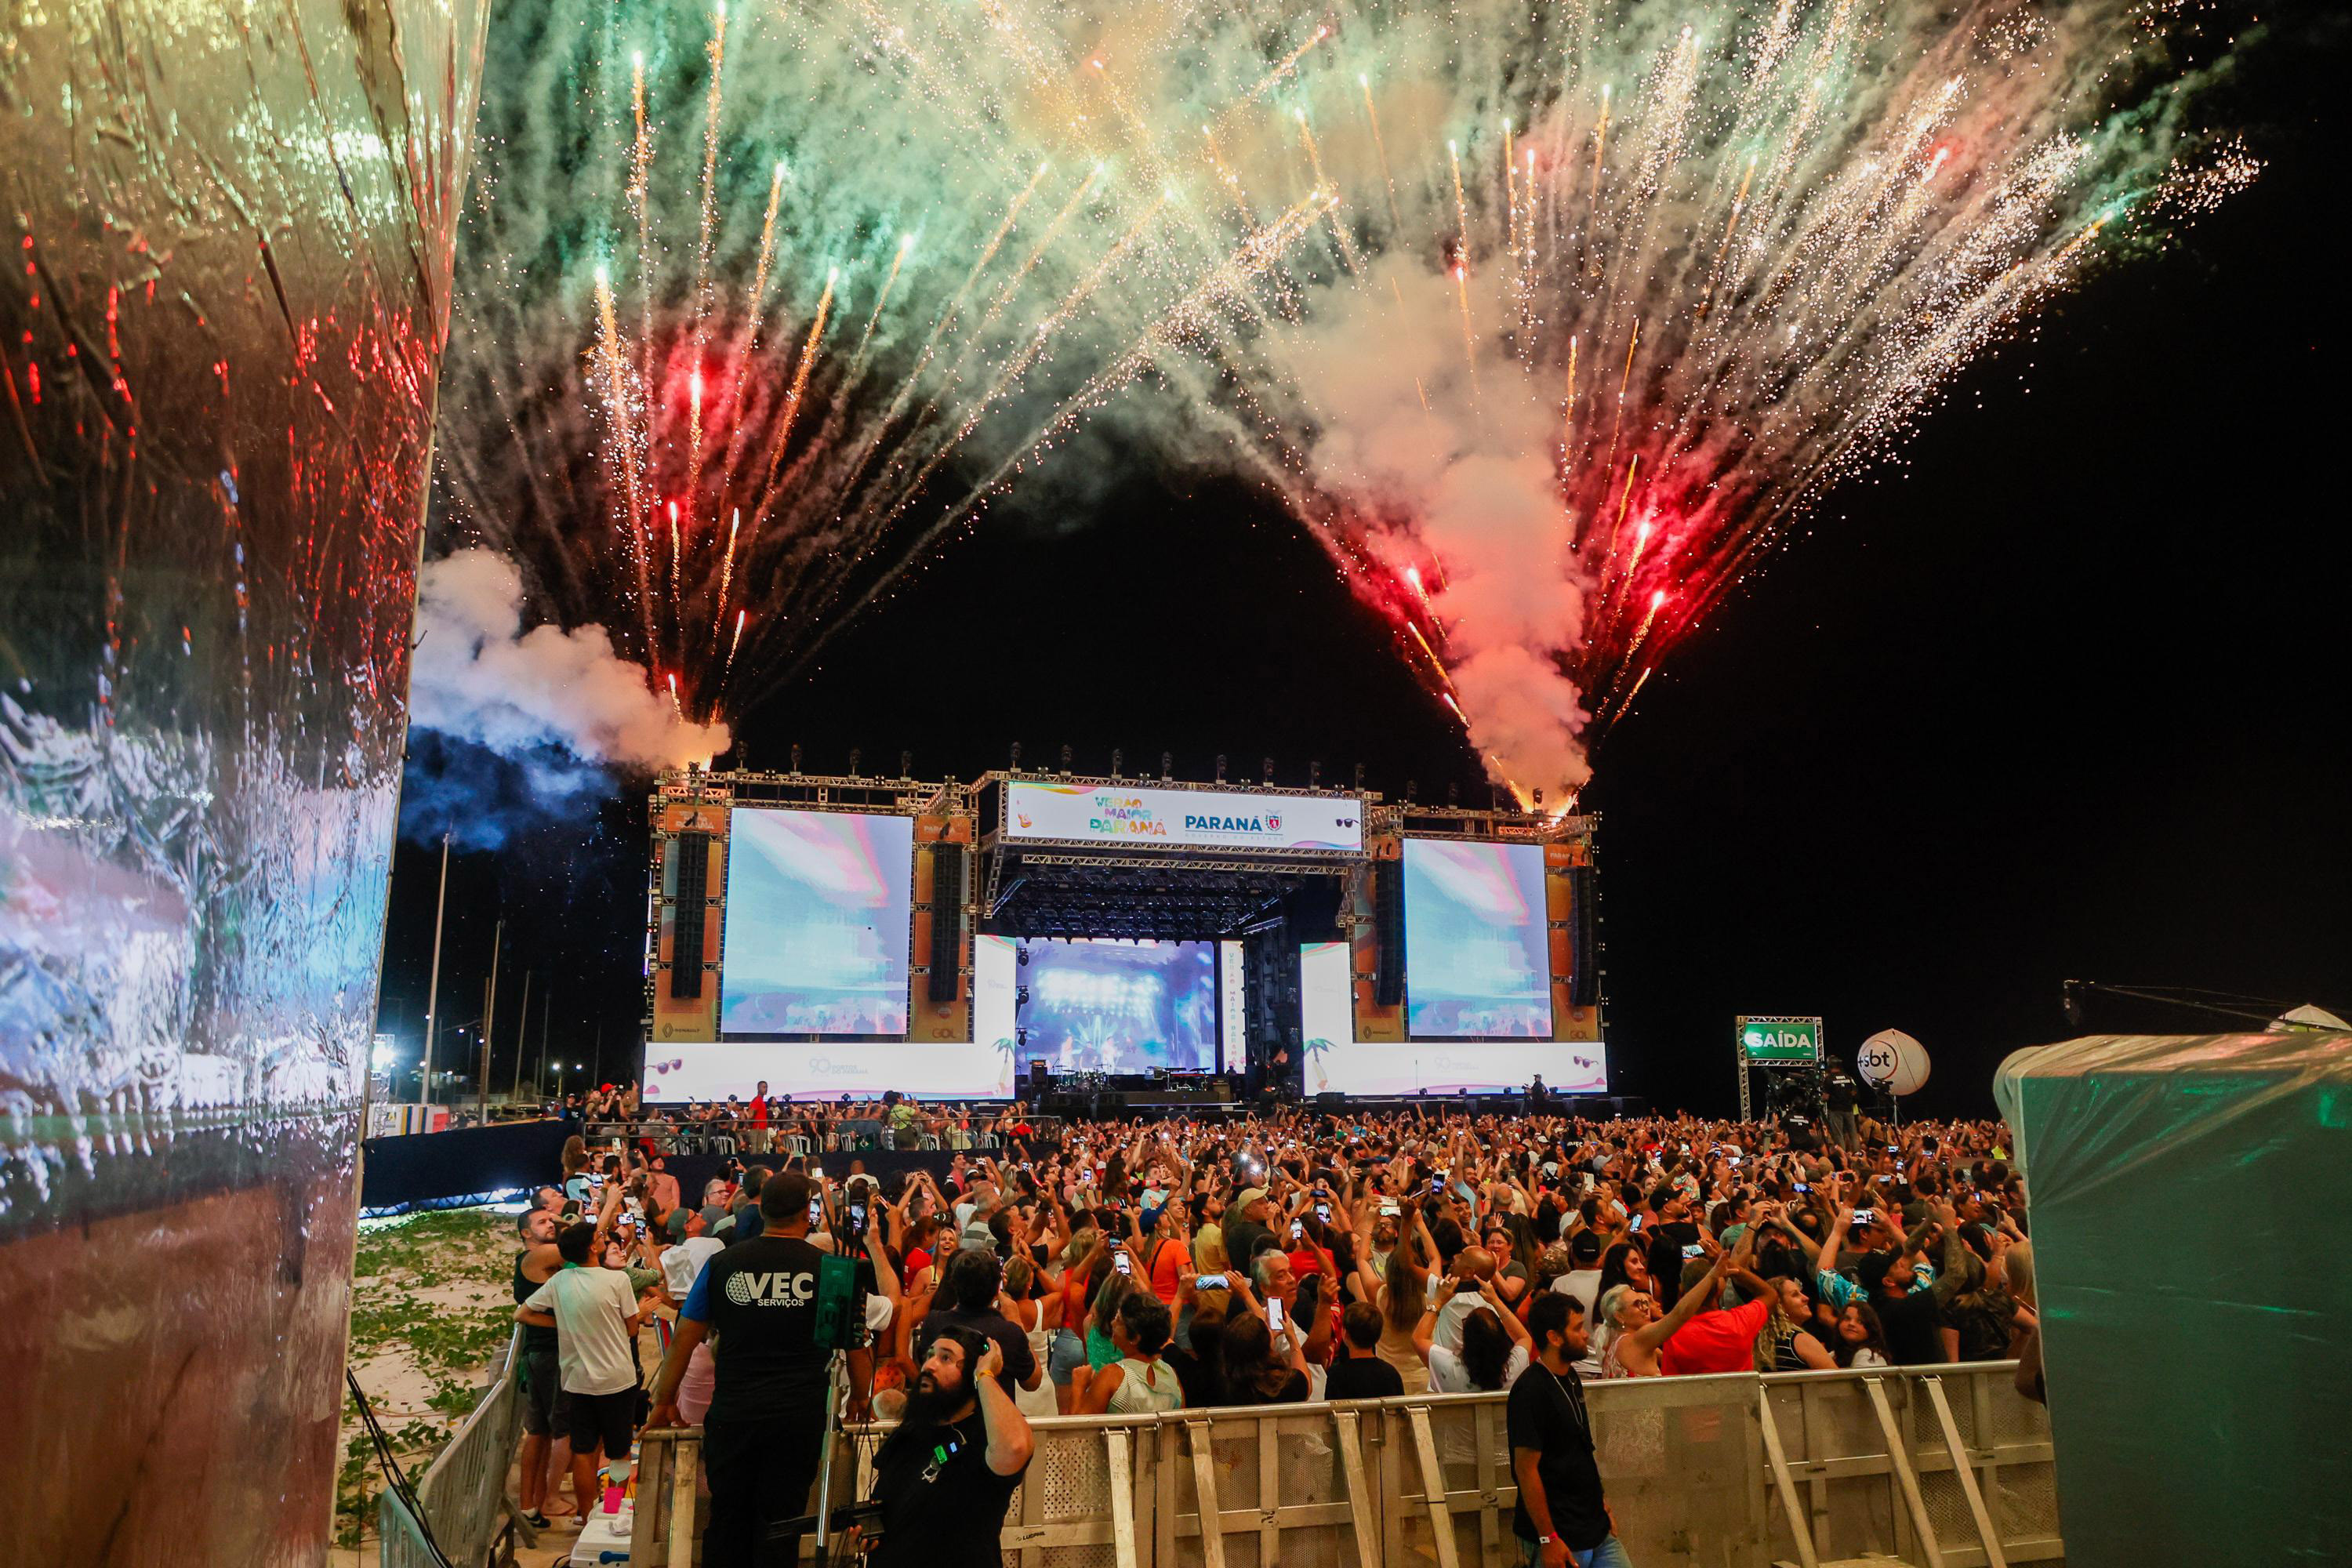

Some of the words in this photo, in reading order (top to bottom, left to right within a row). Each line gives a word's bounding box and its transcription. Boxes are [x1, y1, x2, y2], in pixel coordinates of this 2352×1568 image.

[1104, 808, 1152, 820] MAIOR
[1090, 818, 1167, 836] PARANÁ
[1185, 815, 1263, 832] PARANÁ
[1748, 1029, 1812, 1048] SAÍDA
[744, 1272, 814, 1299] VEC
[757, 1299, 804, 1308] SERVIÇOS
